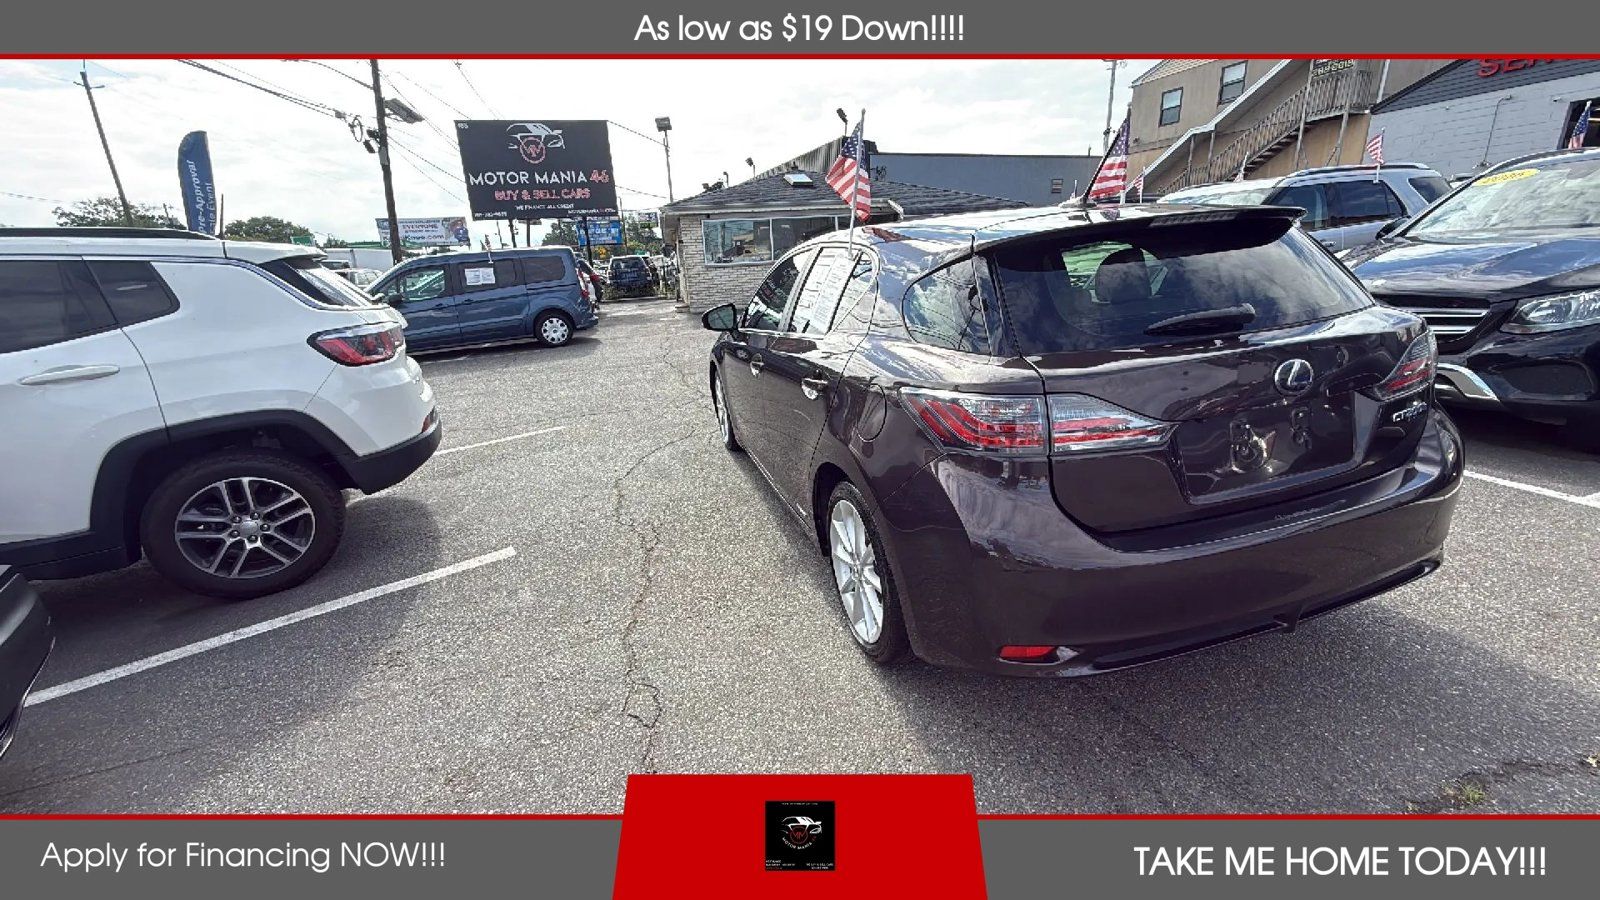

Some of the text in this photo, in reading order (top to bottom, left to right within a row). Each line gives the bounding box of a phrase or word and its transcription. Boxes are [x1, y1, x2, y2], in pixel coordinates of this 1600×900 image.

[468, 169, 610, 186] MOTOR MANIA 46
[494, 187, 591, 201] BUY & SELL CARS
